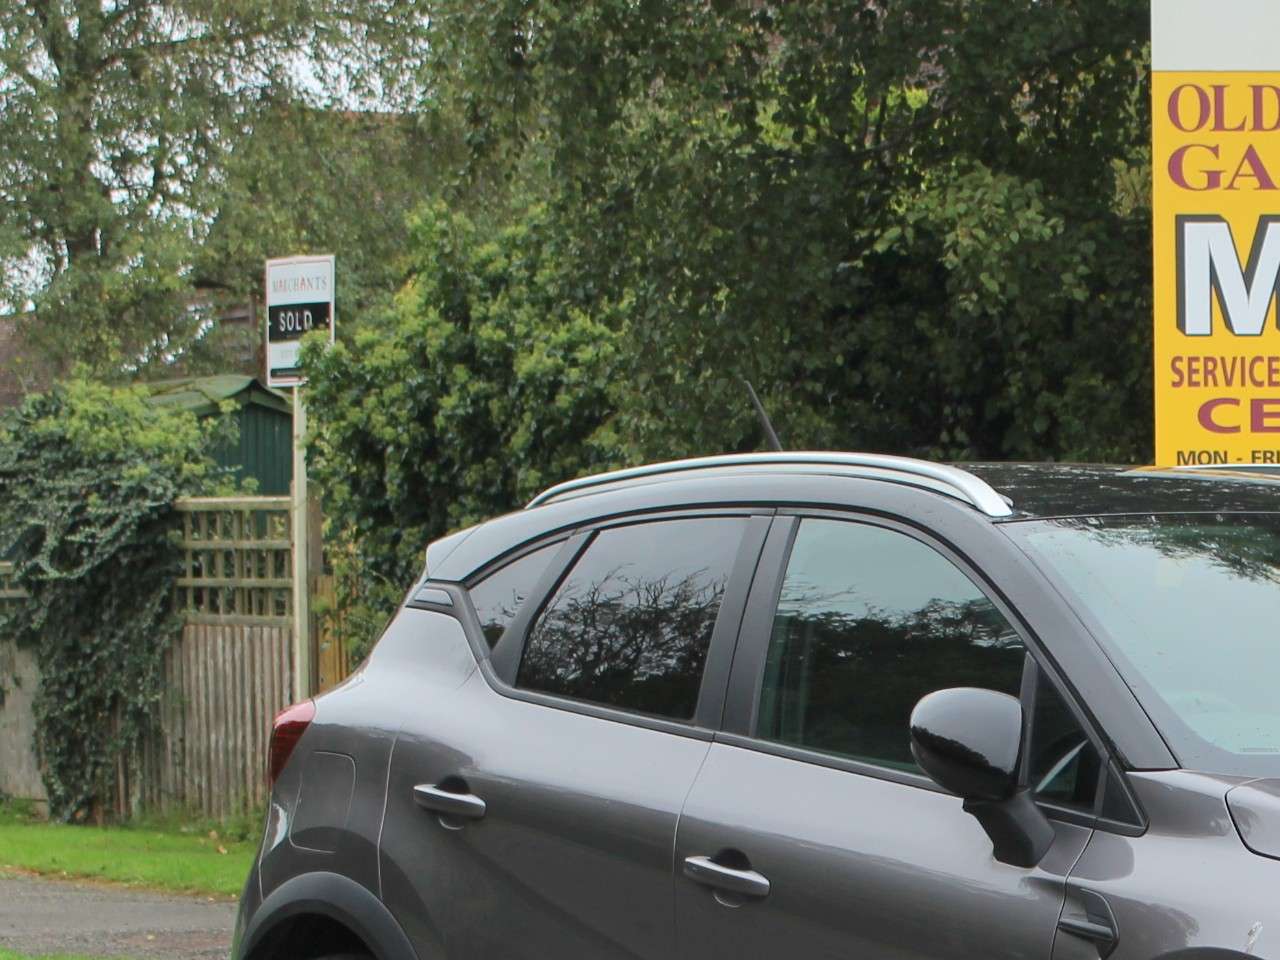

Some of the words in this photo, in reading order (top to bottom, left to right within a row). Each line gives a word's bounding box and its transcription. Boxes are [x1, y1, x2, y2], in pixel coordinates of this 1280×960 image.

[279, 309, 314, 332] SOLD
[1176, 450, 1228, 466] MON
[1251, 450, 1280, 465] FRI
